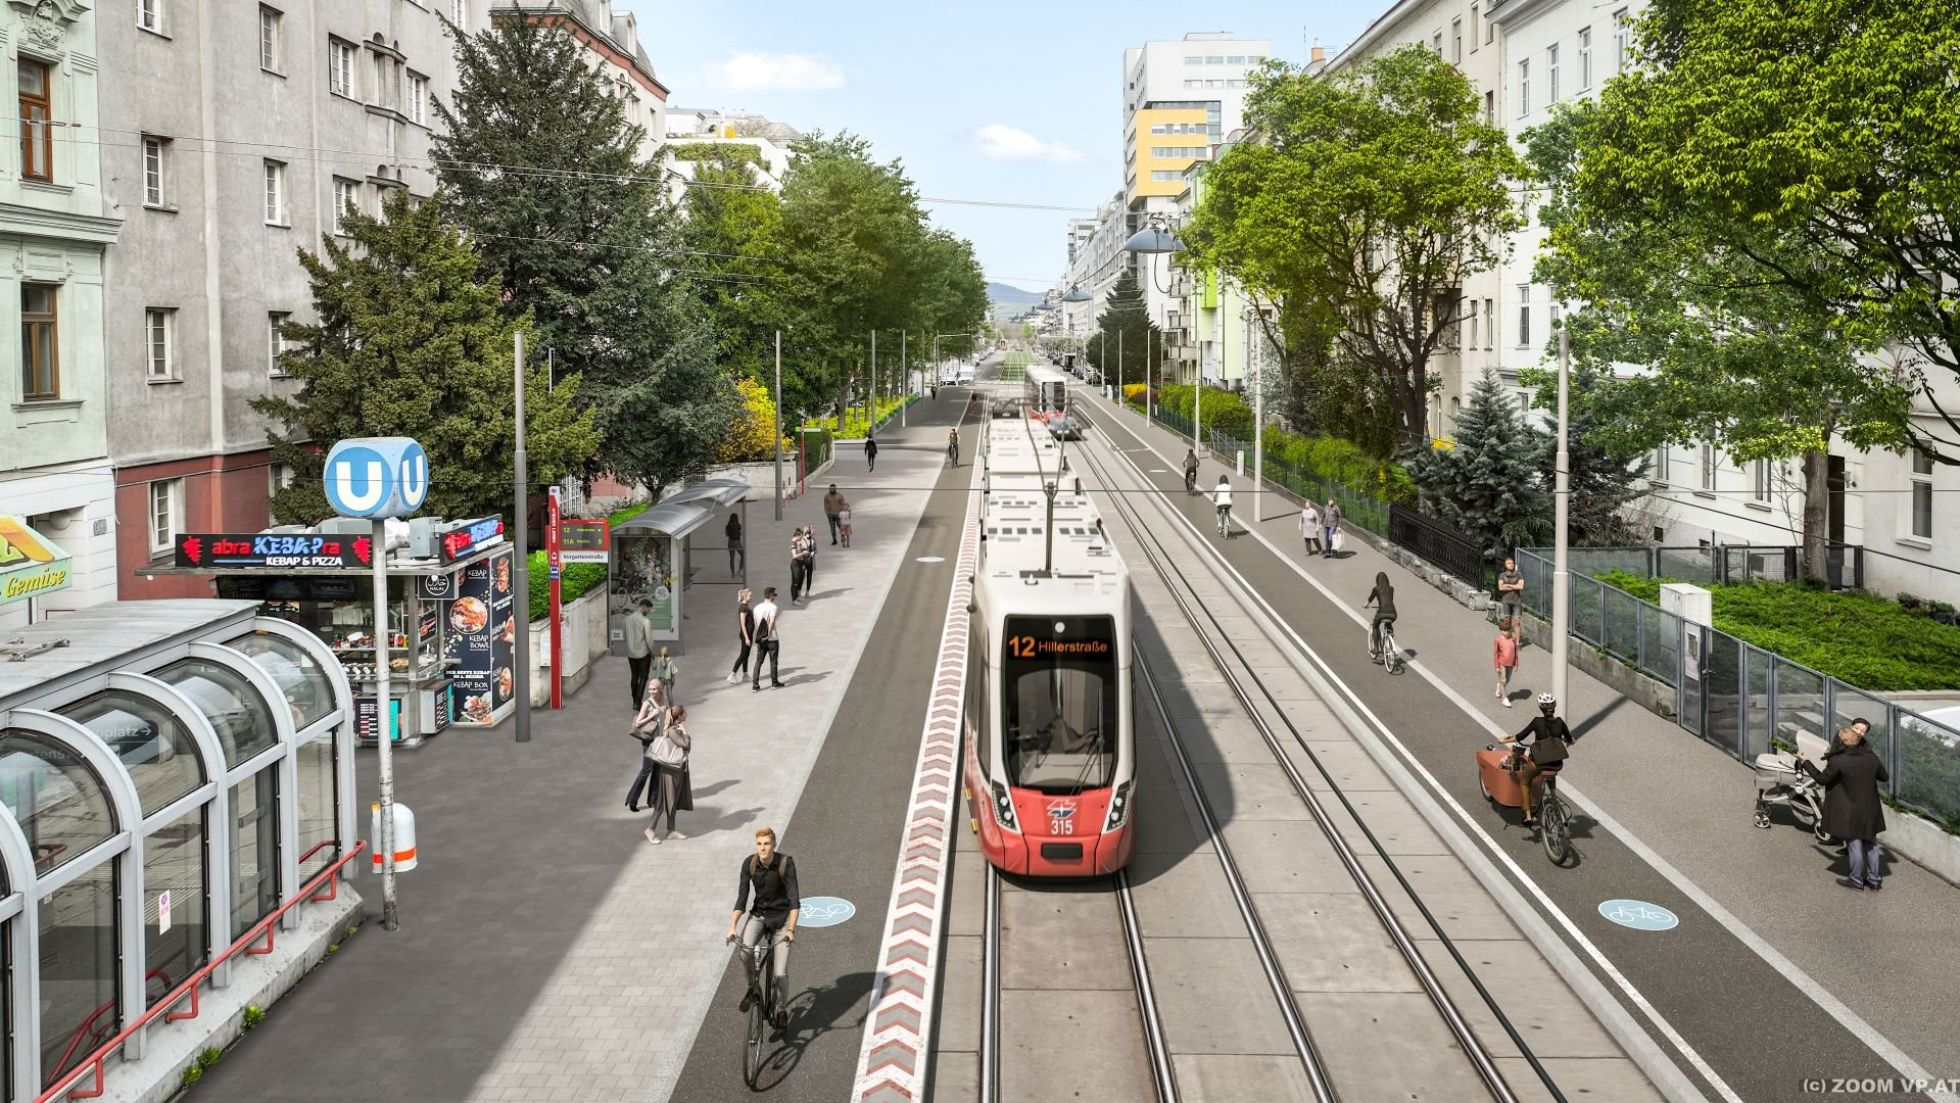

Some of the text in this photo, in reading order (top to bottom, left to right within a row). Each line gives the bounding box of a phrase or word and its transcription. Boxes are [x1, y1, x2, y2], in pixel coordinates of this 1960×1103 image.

[336, 461, 383, 511] U
[402, 454, 424, 506] U
[266, 557, 343, 566] KEBAP & PIZZA
[467, 569, 487, 578] KEBAP
[5, 567, 66, 598] Gemüse
[469, 634, 489, 642] KEBAP
[1009, 636, 1108, 657] 12 Hillerstraße
[453, 681, 472, 690] KEBAP
[1051, 820, 1073, 835] 315
